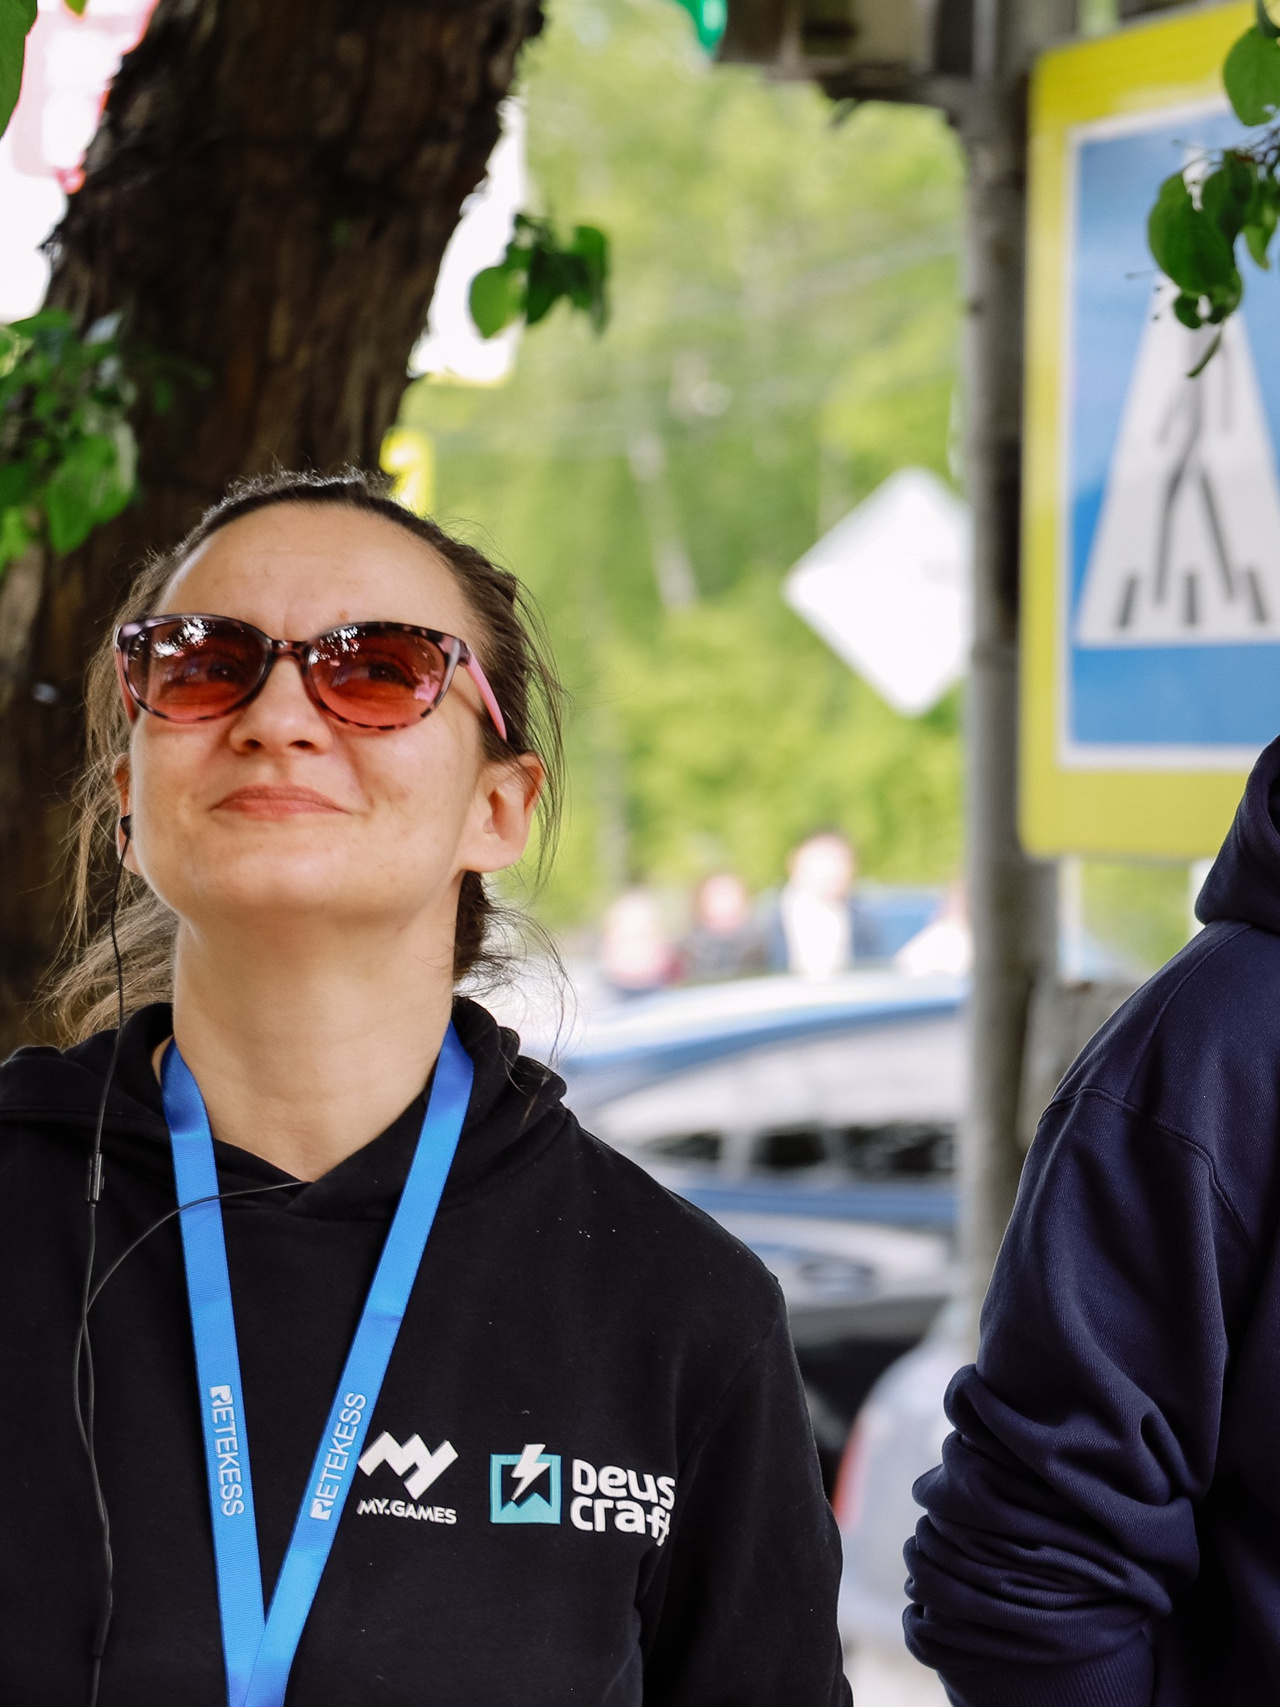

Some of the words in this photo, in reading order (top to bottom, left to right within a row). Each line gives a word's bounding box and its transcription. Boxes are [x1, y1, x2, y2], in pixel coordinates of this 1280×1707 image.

[210, 1384, 244, 1516] RETEKESS
[310, 1392, 366, 1520] RETEKESS
[356, 1498, 457, 1525] MY.GAMES
